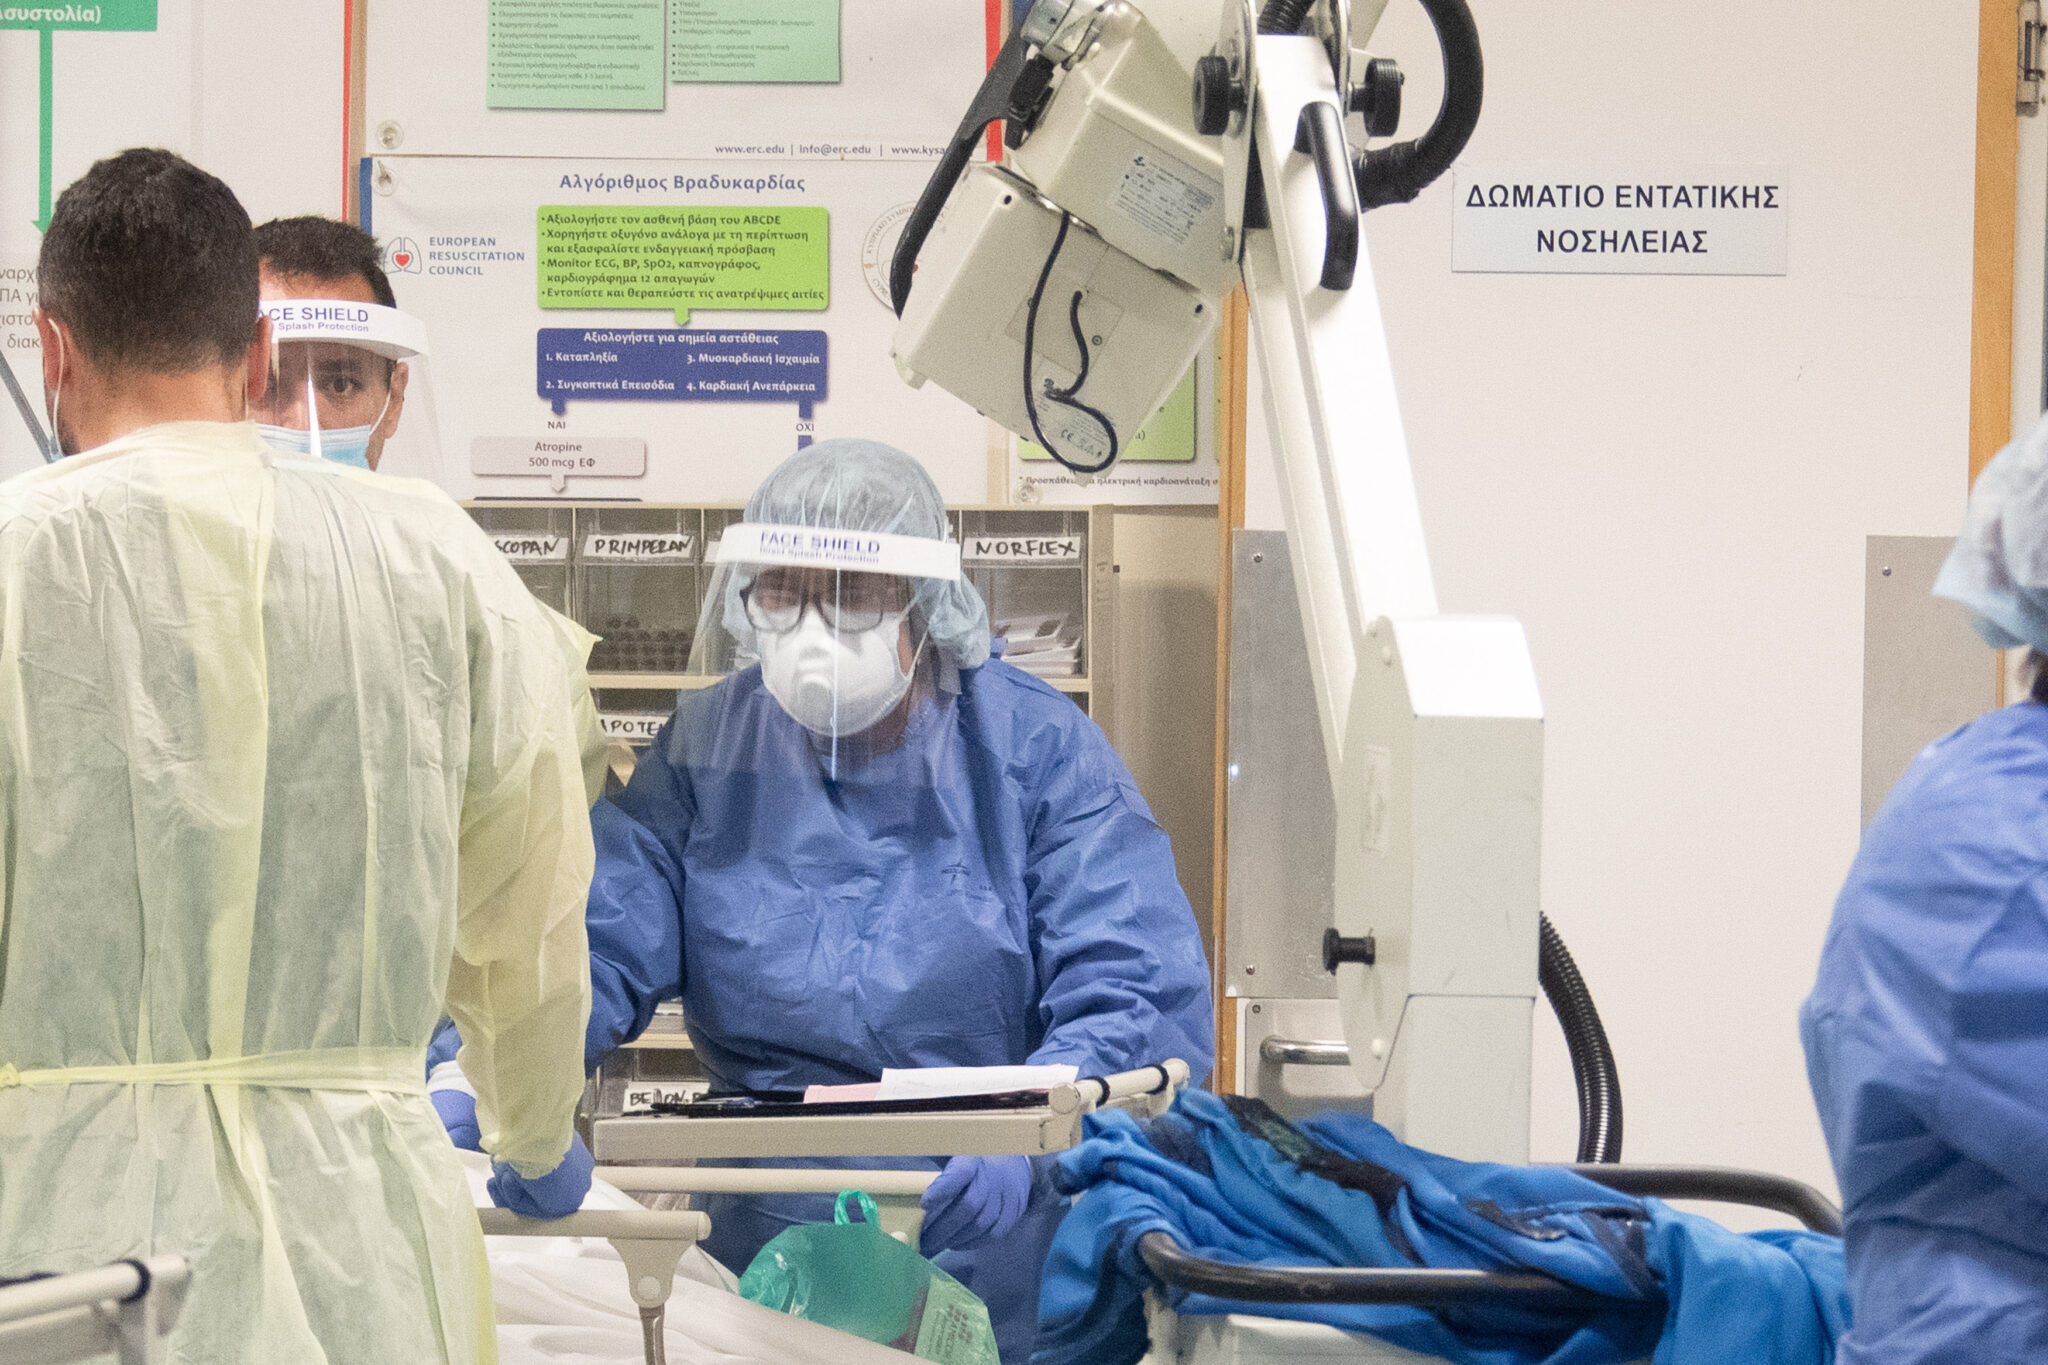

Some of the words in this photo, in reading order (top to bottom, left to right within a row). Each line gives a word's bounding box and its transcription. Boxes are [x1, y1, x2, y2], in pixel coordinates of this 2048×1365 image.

[560, 173, 667, 192] Αλγόριθμος
[674, 174, 805, 193] Βραδυκαρδίας
[1466, 184, 1604, 208] ΔΩΜΑΤΙΟ
[1616, 185, 1778, 208] ΕΝΤΑΤΙΚΗΣ
[547, 214, 616, 226] Αξιολογήστε
[643, 214, 685, 226] ασθενή
[743, 216, 780, 225] ABCDE
[547, 228, 607, 241] Χορηγήστε
[611, 229, 657, 241] οξυγόνο
[661, 229, 709, 241] ανάλογα
[713, 232, 725, 241] με
[729, 232, 742, 241] τη
[746, 229, 808, 242] περίπτωση
[430, 237, 496, 246] EUROPEAN
[1538, 230, 1707, 253] ΝΟΣΗΛΕΙΑΣ
[717, 244, 775, 256] πρόσβαση
[429, 252, 524, 261] RESUSCITATION
[547, 258, 591, 267] Monitor
[595, 259, 619, 269] ECG,
[623, 259, 640, 269] BP,
[429, 266, 483, 275] COUNCIL
[547, 273, 637, 285] καρδιογράφημα
[641, 275, 650, 283] 12
[547, 287, 603, 297] Εντοπίστε
[699, 291, 713, 299] τις
[792, 289, 824, 300] αιτίες
[302, 307, 368, 322] SHIELD
[0, 314, 34, 329] ιστο
[279, 322, 314, 331] Splash
[318, 321, 369, 332] Protection
[584, 331, 654, 344] Αξιολογήστε
[658, 335, 675, 344] για
[678, 332, 716, 345] σημεία
[719, 332, 778, 345] αστάθειας
[622, 380, 674, 390] Επεισόδια
[752, 381, 815, 393] Ανεπάρκεια
[548, 421, 566, 429] ΝΑΙ
[796, 422, 814, 431] ΟΧΙ
[535, 442, 582, 453] Atropine
[529, 457, 549, 466] 500
[552, 460, 574, 469] mcg
[975, 540, 1076, 556] NORFLEX
